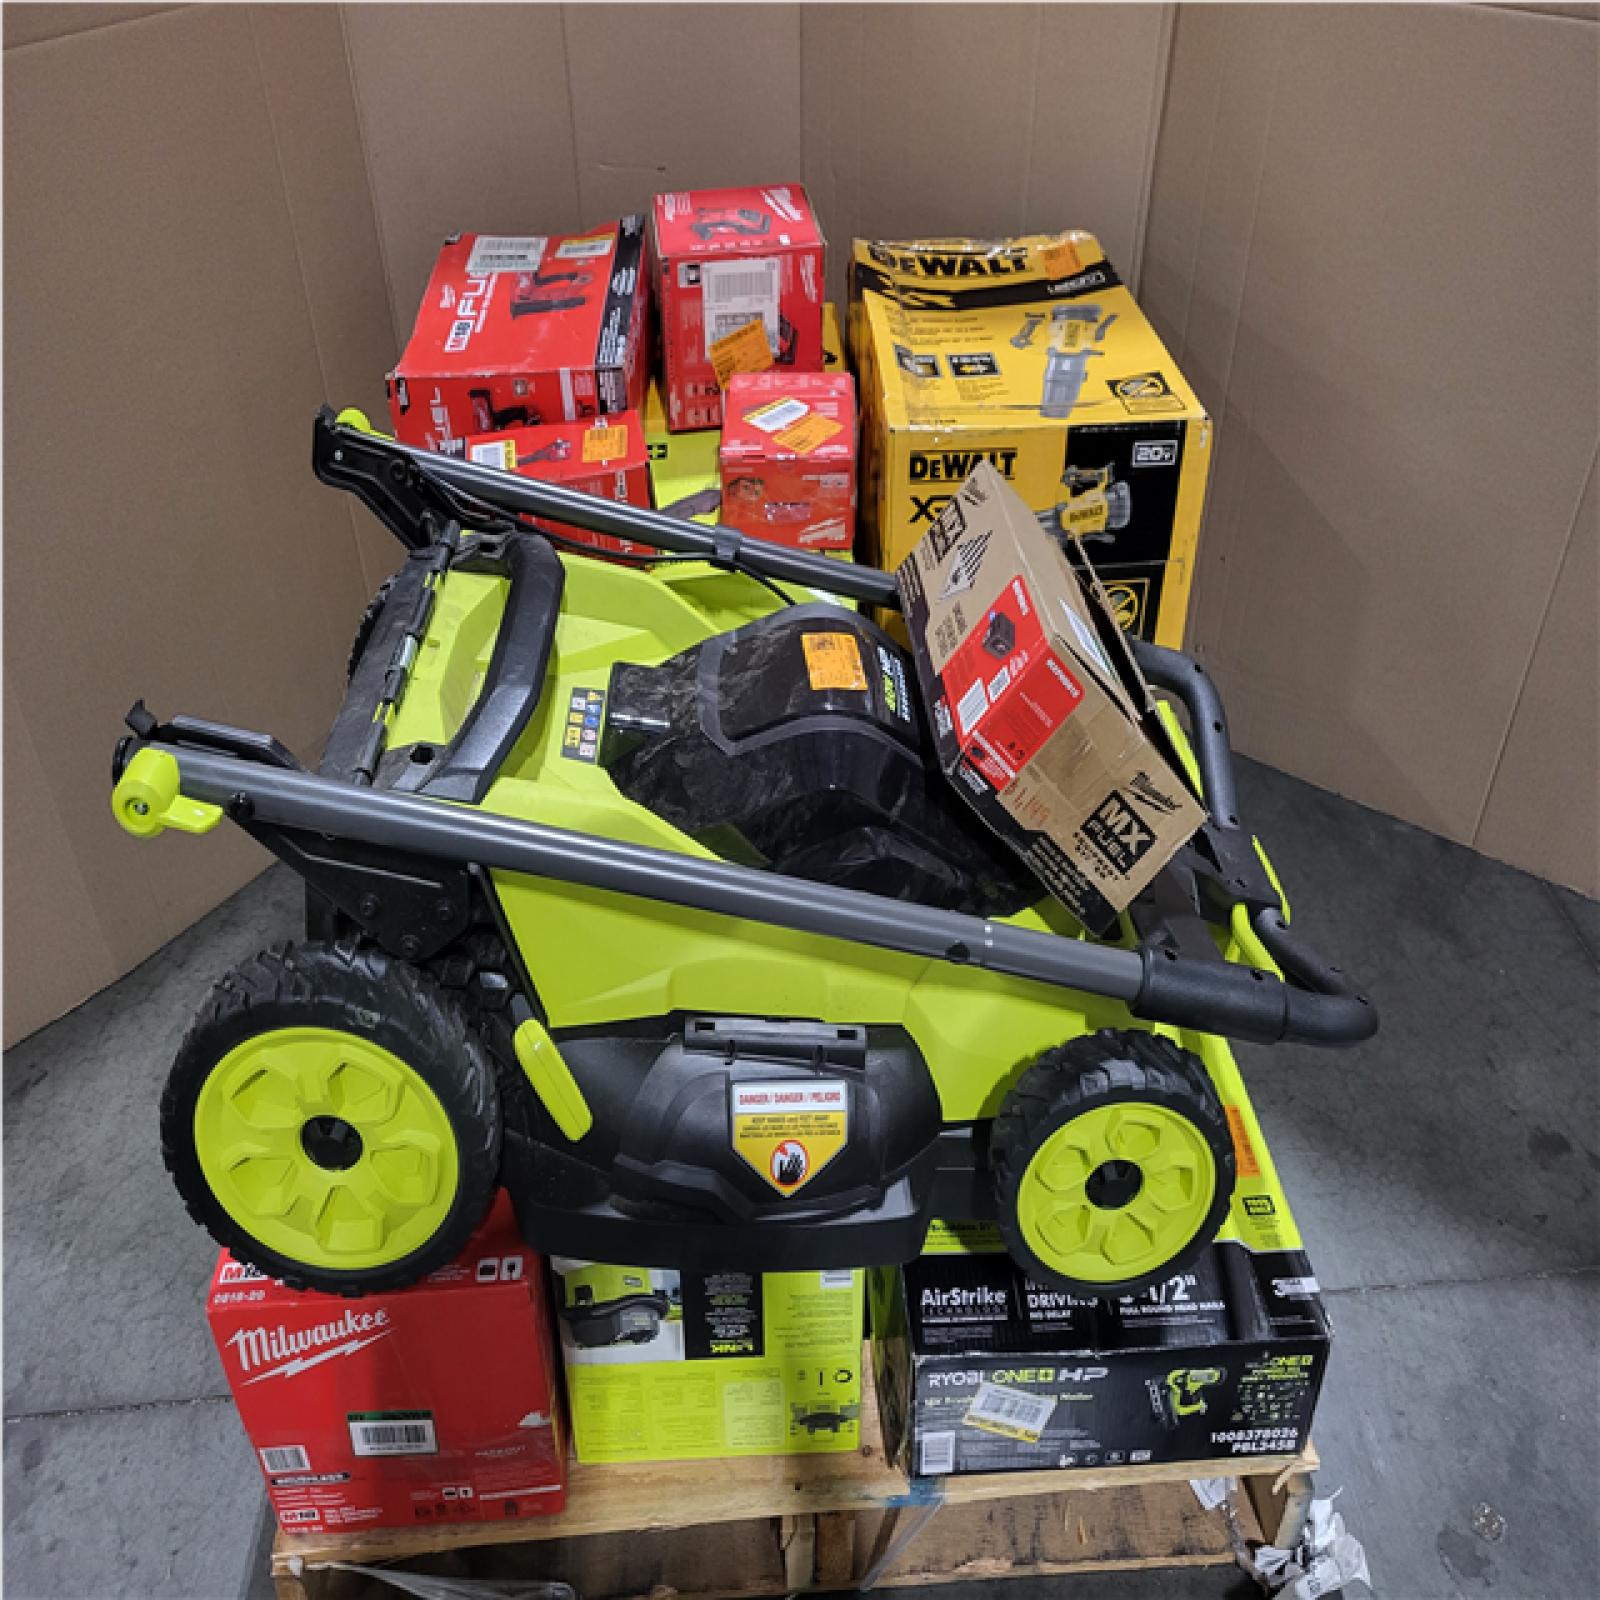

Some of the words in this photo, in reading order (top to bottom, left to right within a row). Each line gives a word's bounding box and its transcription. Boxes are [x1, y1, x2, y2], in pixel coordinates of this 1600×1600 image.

[1099, 797, 1152, 856] MX
[922, 1286, 1007, 1306] AirStrike
[226, 1309, 390, 1371] Milwaukee
[928, 1369, 983, 1388] RYOBI
